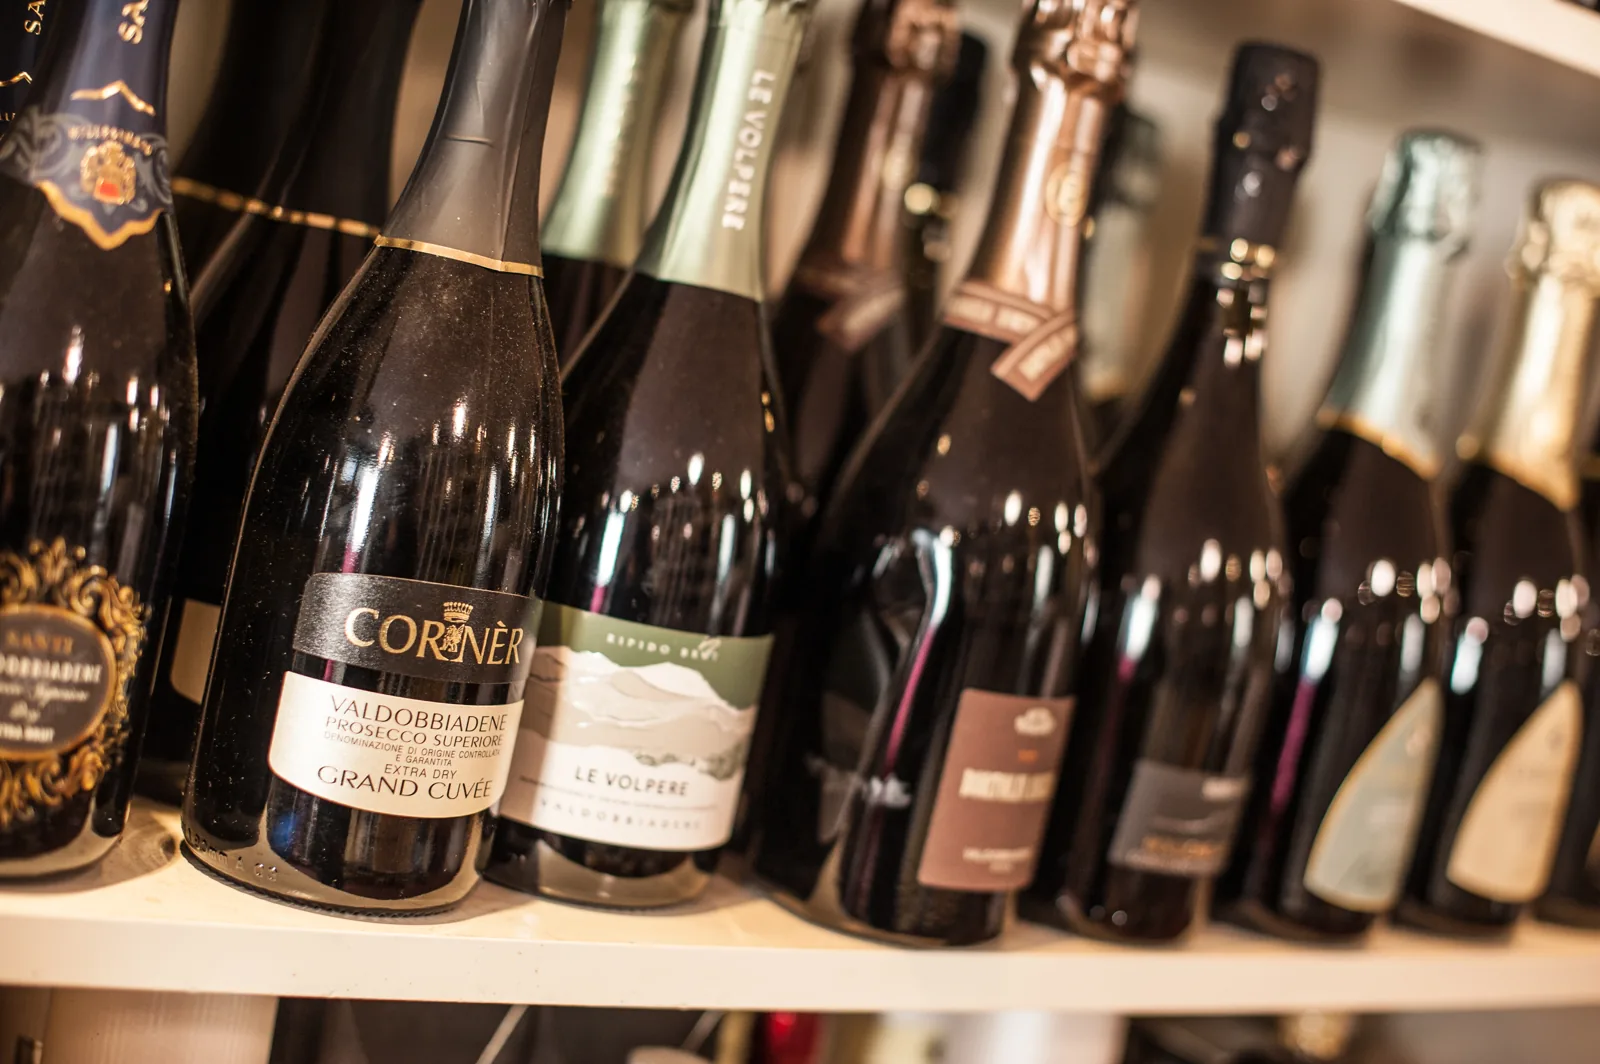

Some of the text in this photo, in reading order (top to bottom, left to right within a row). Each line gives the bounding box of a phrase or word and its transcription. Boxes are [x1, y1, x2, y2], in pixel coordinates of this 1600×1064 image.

[722, 69, 776, 231] LE VOLPERE
[344, 607, 524, 665] CORNÈR
[606, 633, 670, 655] RIPIDO
[331, 695, 508, 733] VALDOBBIADENE
[323, 730, 501, 758] DENOMINAZIONE DI ORIGINE CONTROLLATA
[326, 716, 503, 748] PROSECCO SUPERIORE
[384, 764, 458, 780] EXTRA DRY
[395, 754, 453, 766] E GARANTITA
[317, 766, 419, 796] GRAND
[428, 778, 494, 800] CUVÉE
[574, 765, 598, 783] LE
[605, 772, 690, 796] VOLPERE
